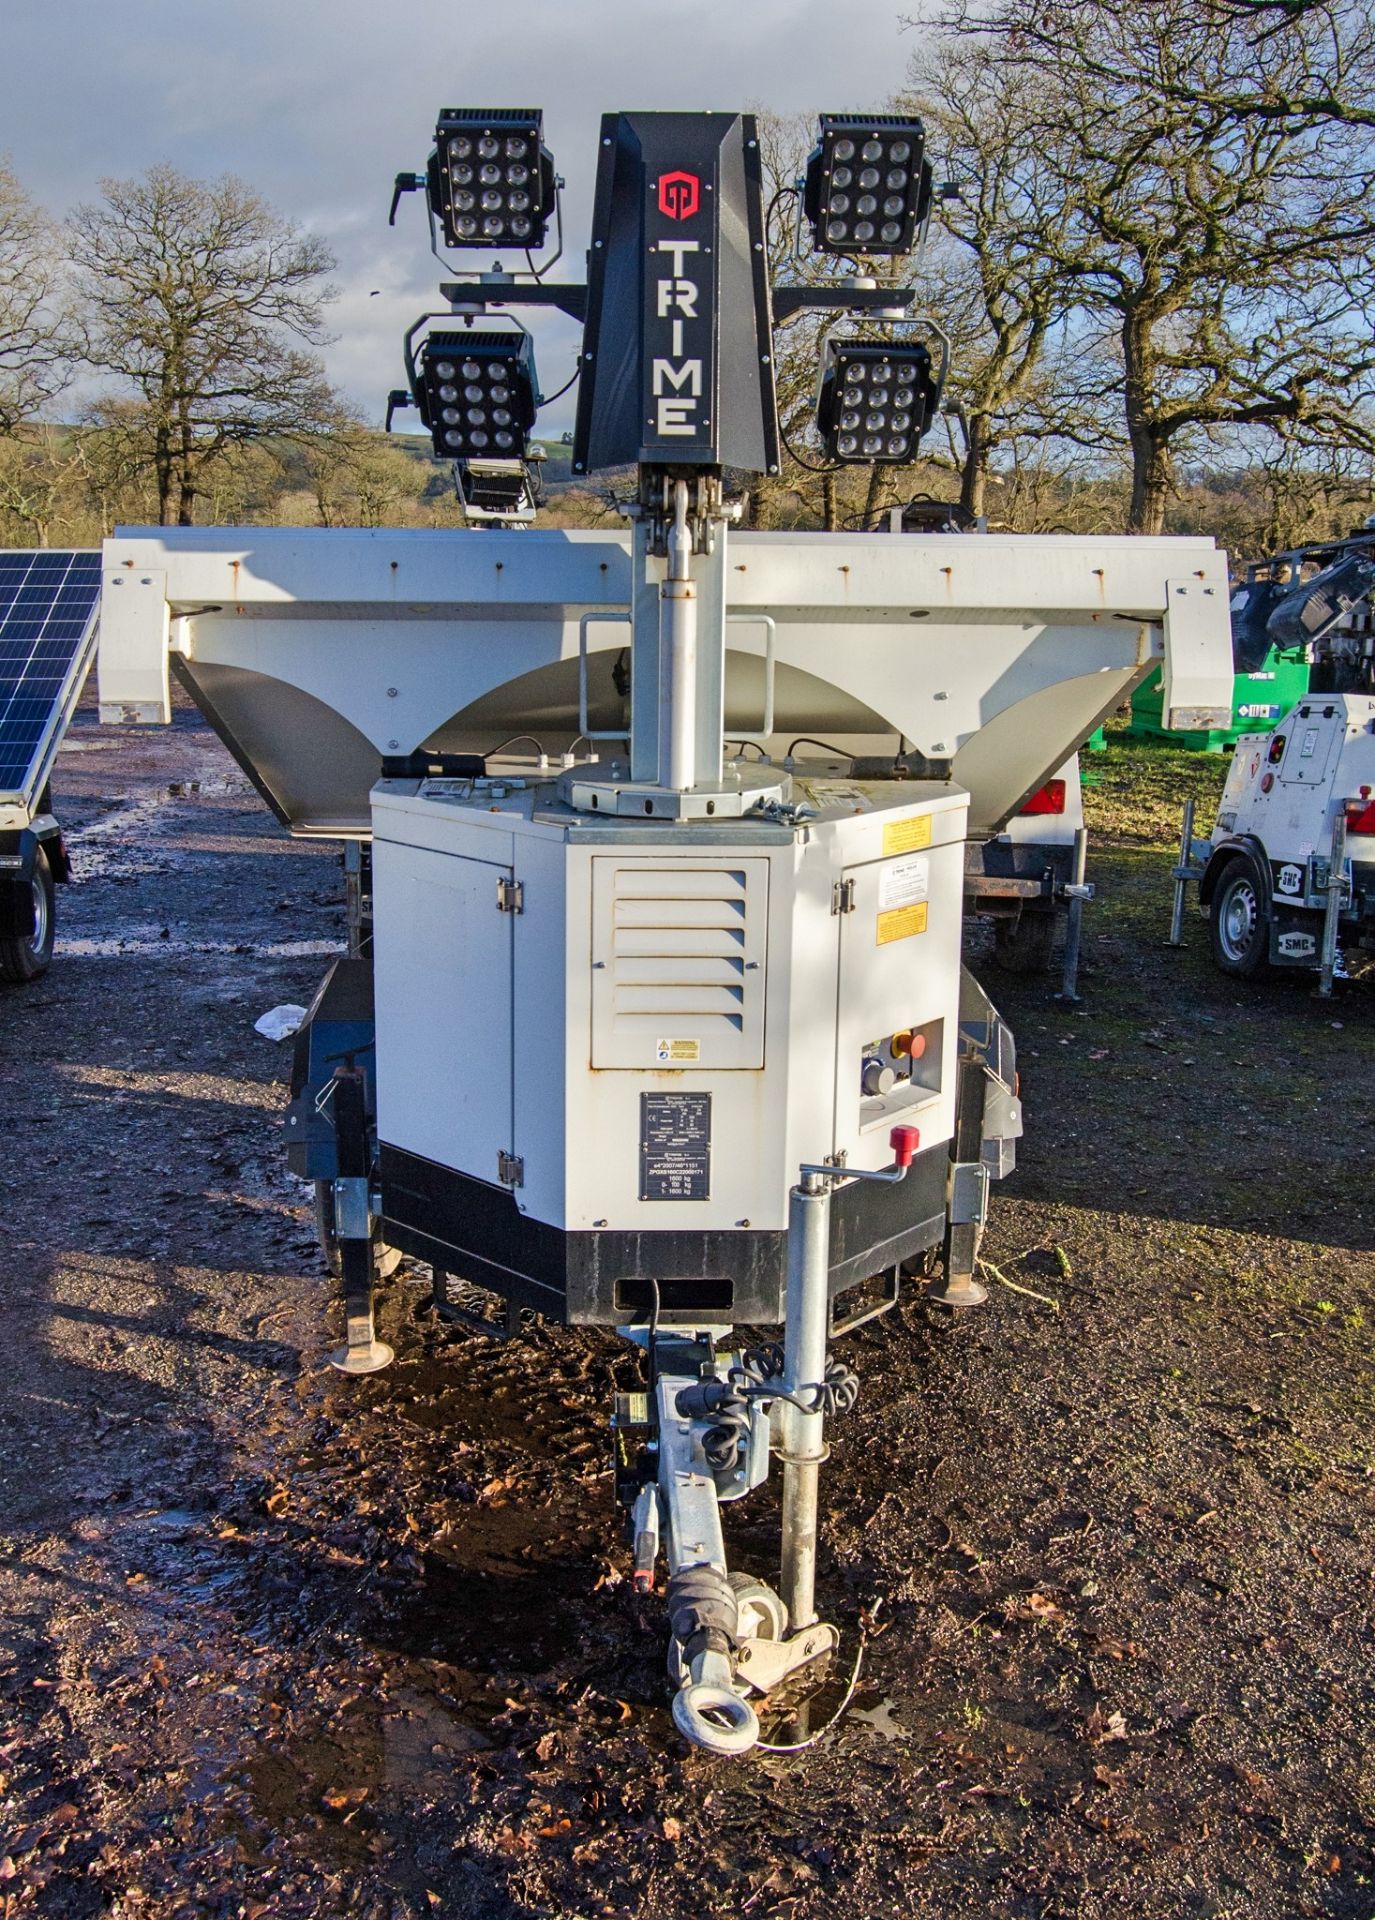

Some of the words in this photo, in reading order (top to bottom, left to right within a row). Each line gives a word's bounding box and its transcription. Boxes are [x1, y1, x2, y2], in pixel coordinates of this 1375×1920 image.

[652, 240, 703, 436] TRIME
[1282, 871, 1298, 888] SMC
[1285, 938, 1309, 950] SMC
